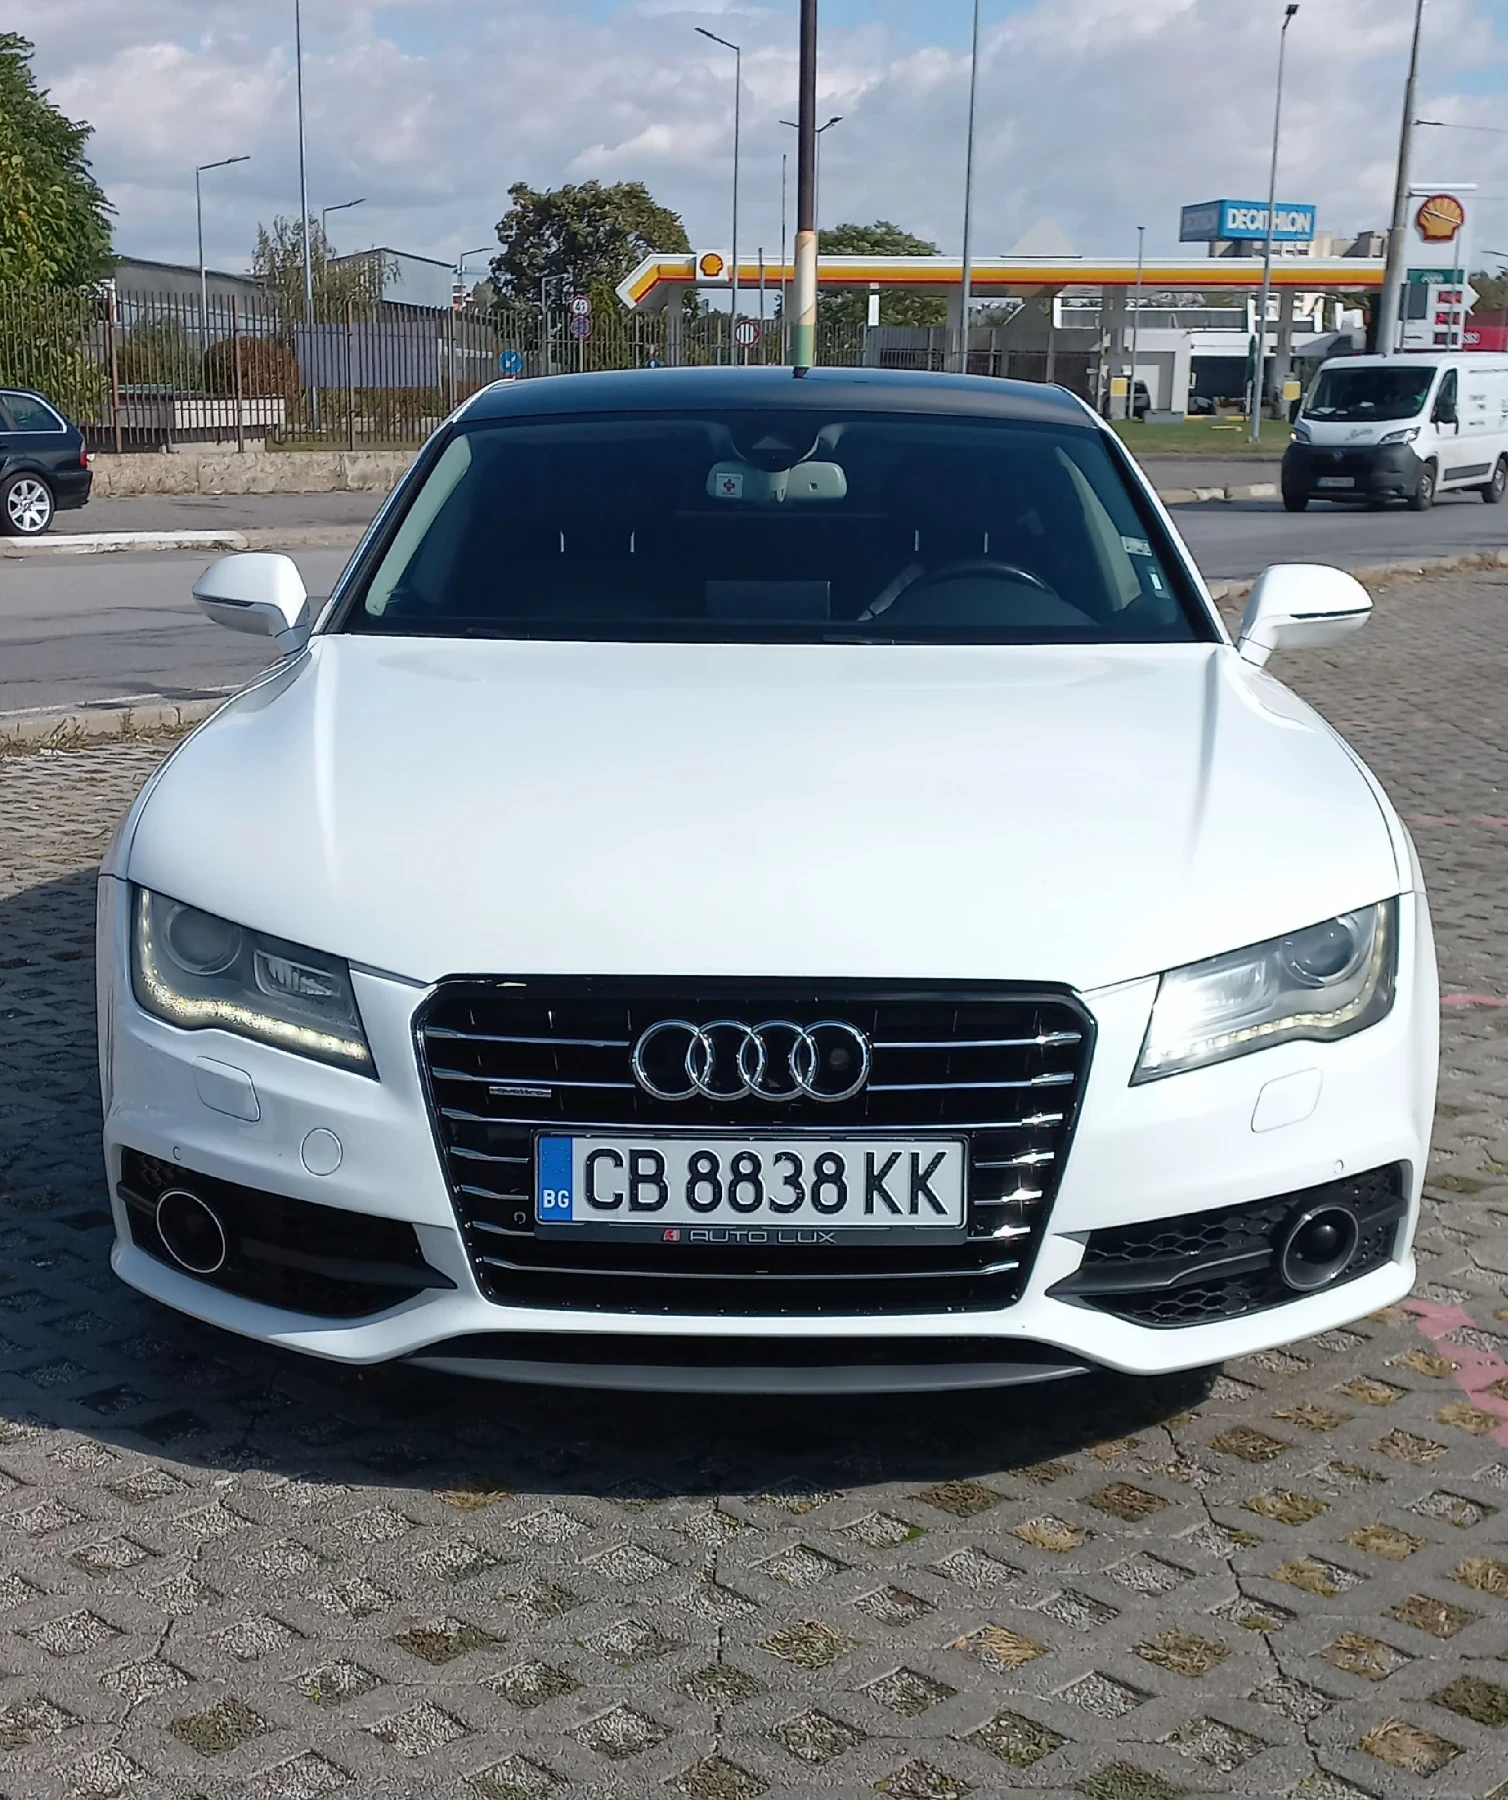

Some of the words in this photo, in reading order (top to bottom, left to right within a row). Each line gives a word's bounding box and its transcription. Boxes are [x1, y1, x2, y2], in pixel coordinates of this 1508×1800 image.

[1226, 208, 1312, 232] DECATHLON
[584, 1147, 670, 1213] CB
[685, 1150, 848, 1215] 8838
[863, 1151, 950, 1215] KK
[543, 1189, 570, 1208] BG
[690, 1230, 767, 1244] AUTO
[778, 1231, 836, 1245] LUX
